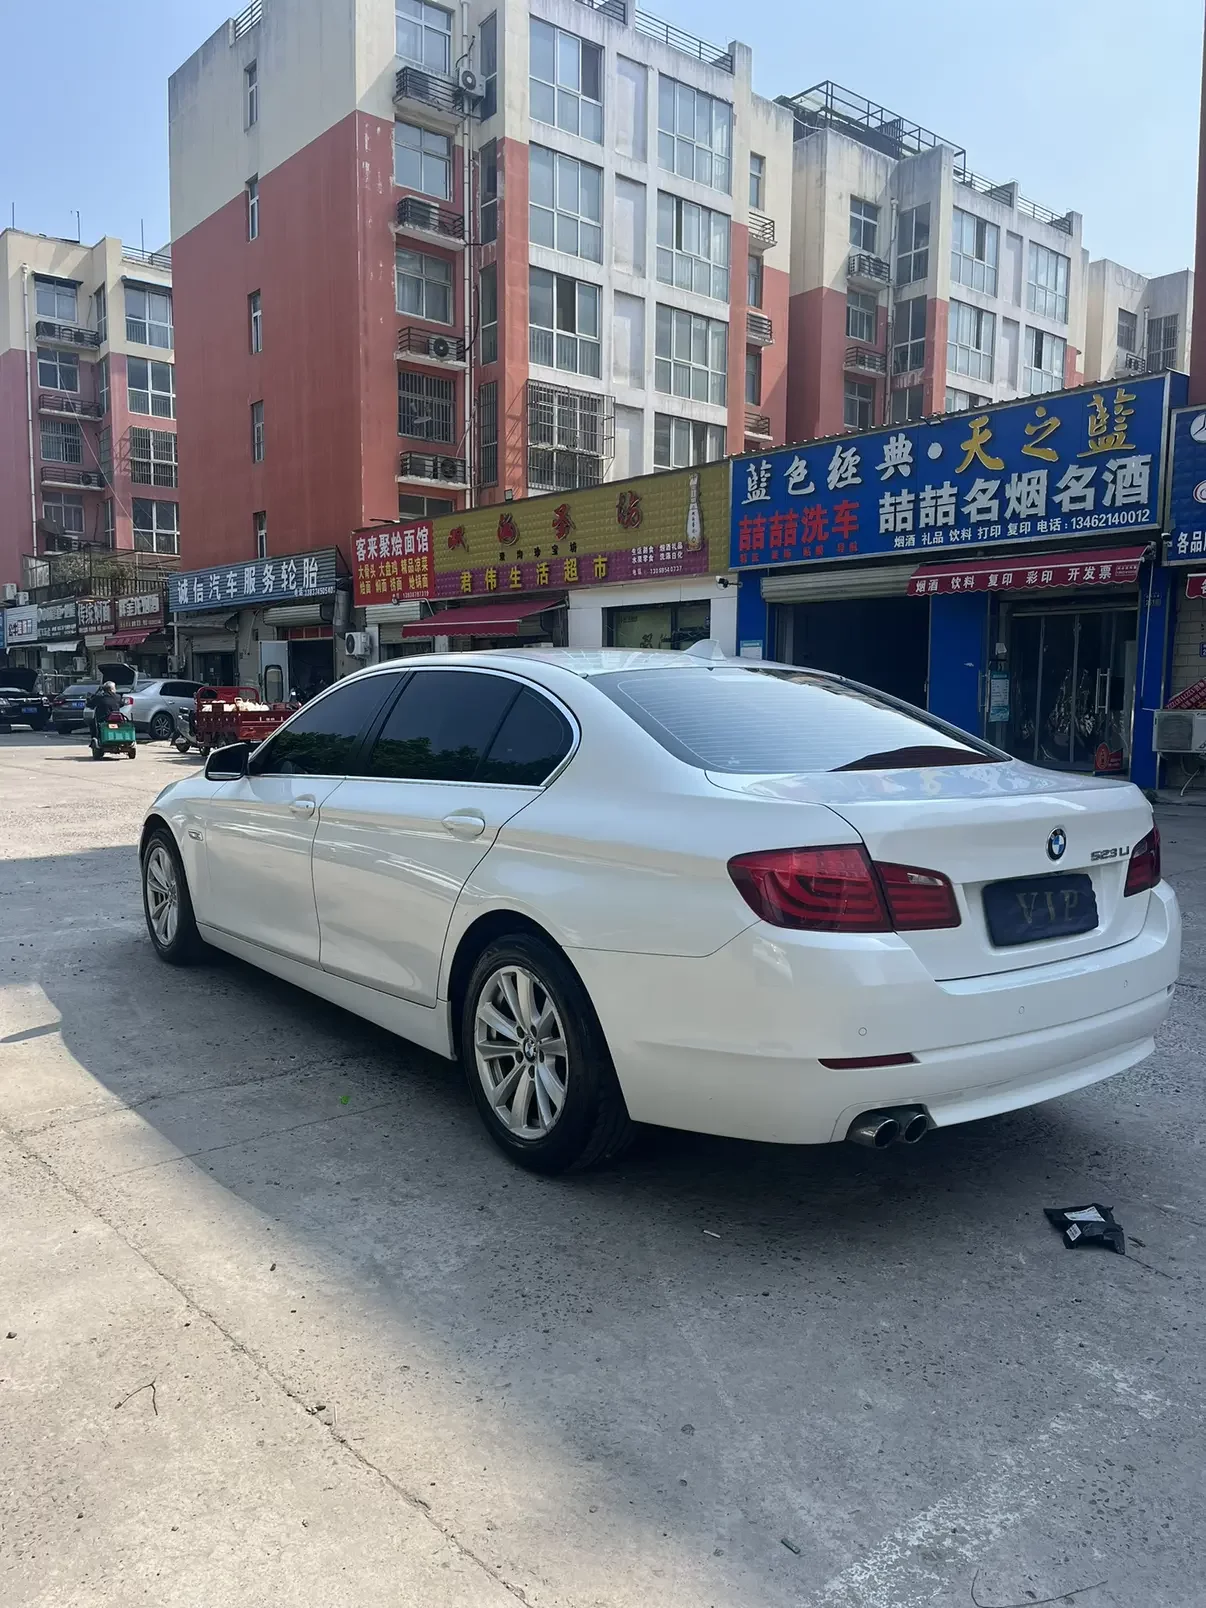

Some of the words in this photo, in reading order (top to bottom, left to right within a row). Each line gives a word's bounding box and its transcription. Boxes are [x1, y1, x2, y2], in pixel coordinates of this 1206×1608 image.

[879, 454, 1152, 534] 喆喆名烟名酒
[356, 526, 429, 562] 客来聚烩面馆
[894, 534, 916, 548] 烟酒
[921, 531, 944, 545] 礼品
[949, 527, 972, 542] 饮料
[977, 525, 1002, 540] 打印
[1007, 521, 1031, 536] 复印
[1177, 531, 1206, 554] 各品
[177, 557, 319, 605] 诚信汽车服务轮胎
[460, 554, 608, 593] 君伟生活超市
[915, 579, 939, 593] 烟酒
[951, 575, 975, 590] 饮料
[987, 572, 1013, 587] 复印
[1026, 570, 1053, 585] 彩印
[1068, 564, 1113, 582] 开发票
[1016, 889, 1079, 924] VIP
